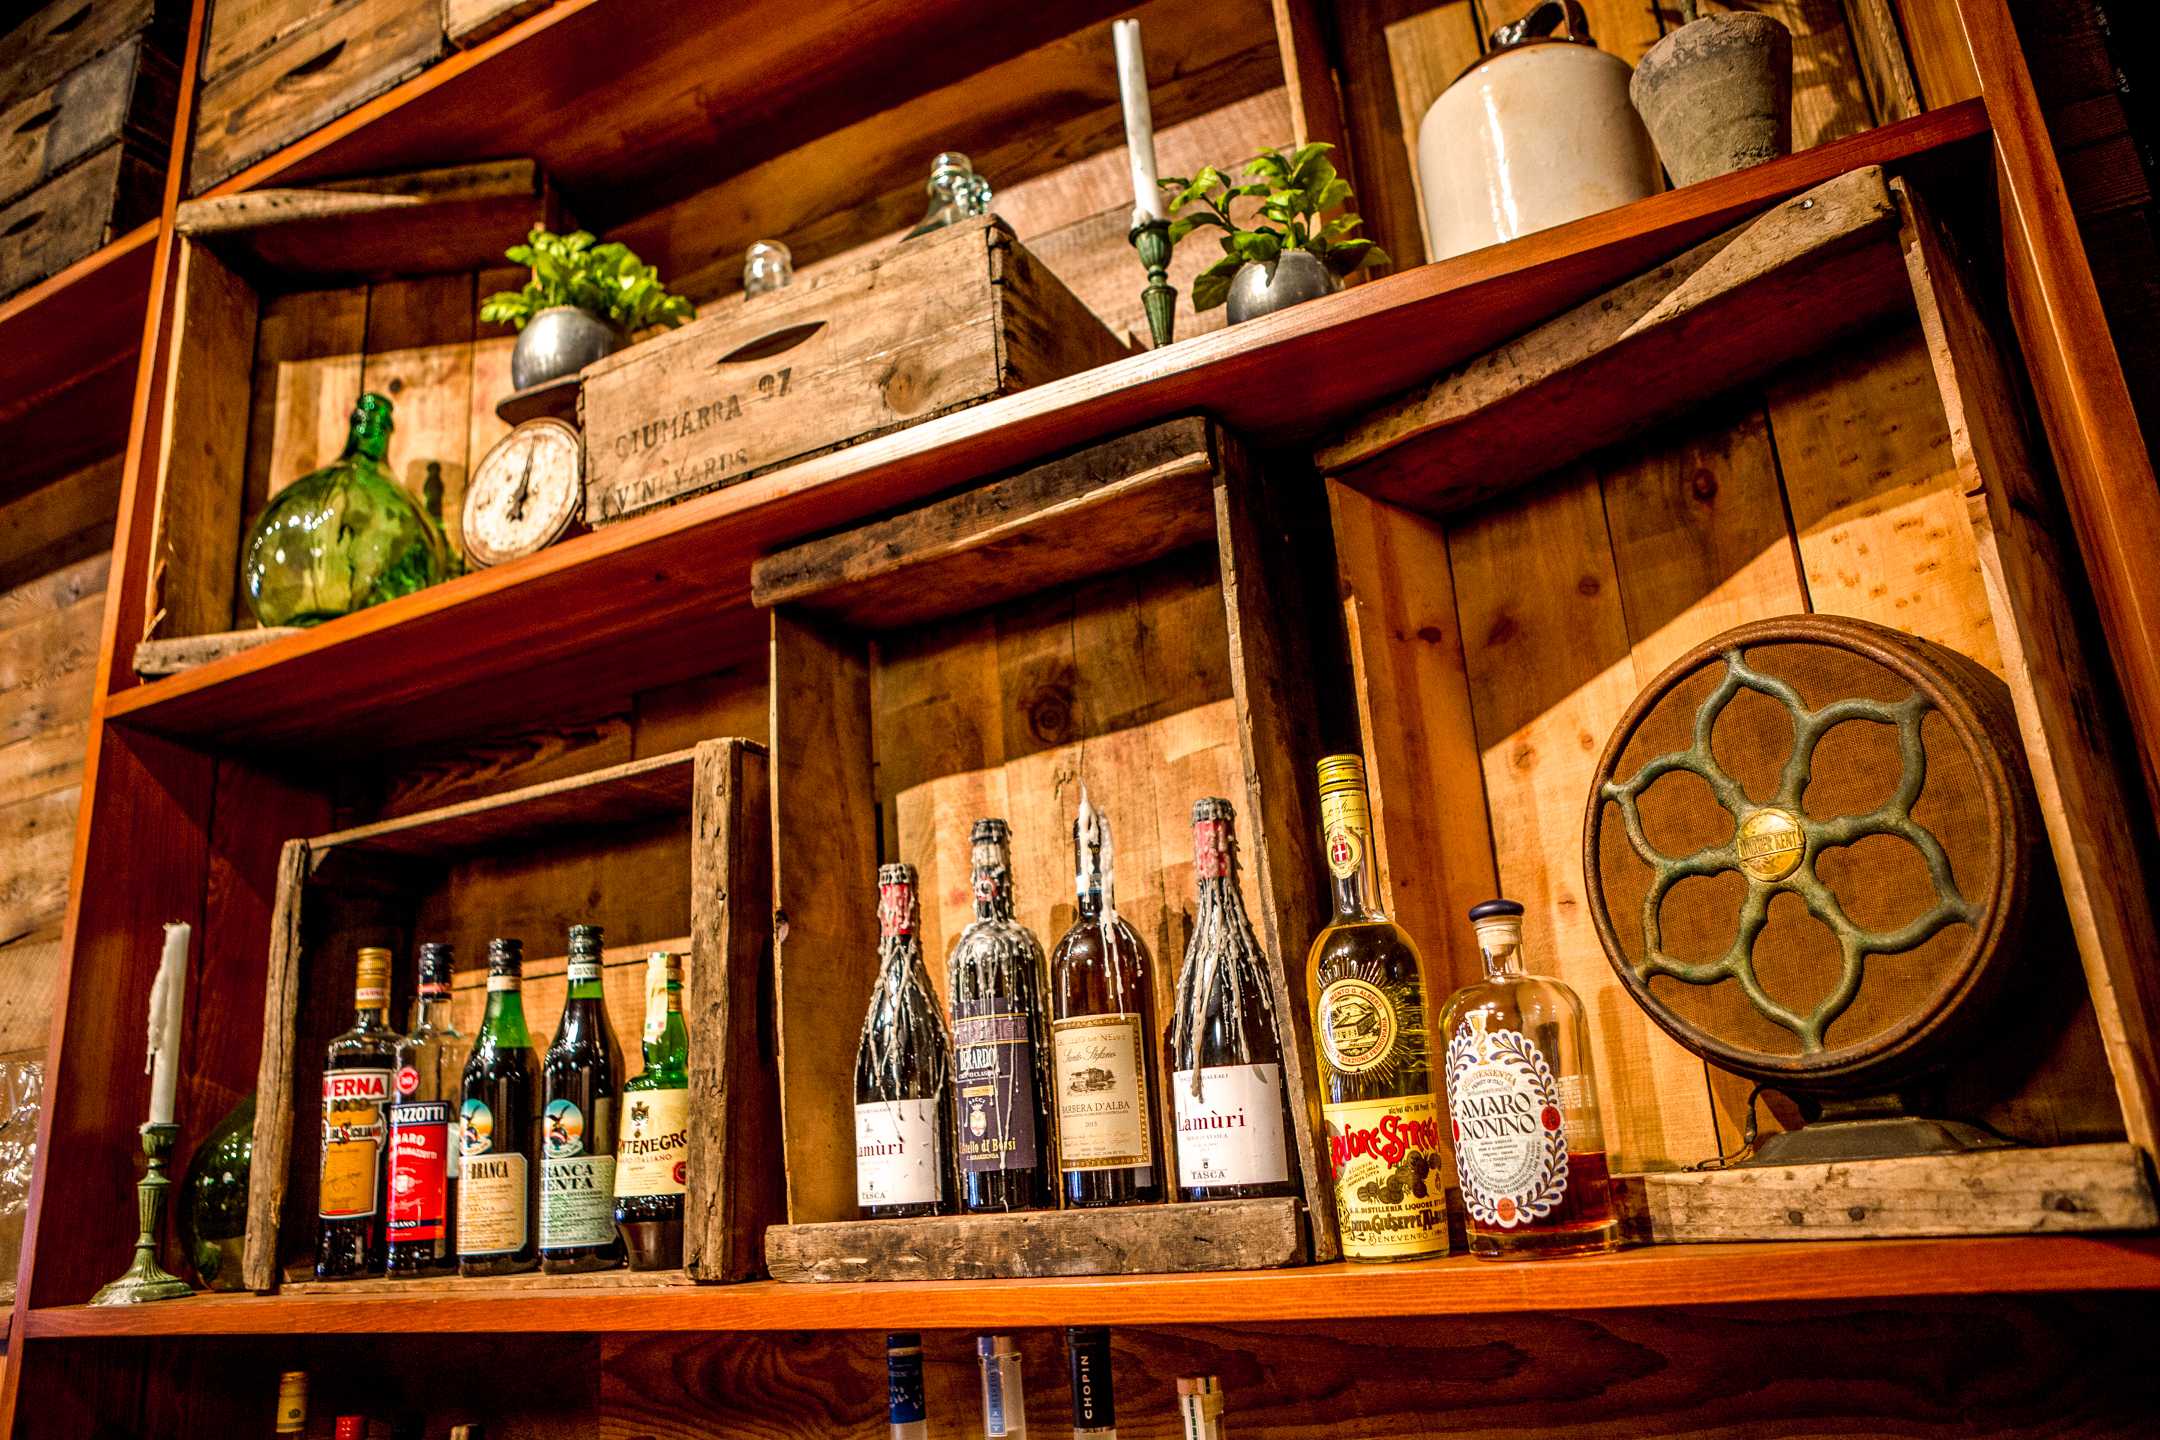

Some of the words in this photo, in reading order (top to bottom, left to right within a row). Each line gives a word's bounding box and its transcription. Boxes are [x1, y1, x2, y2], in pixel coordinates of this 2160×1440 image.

[1095, 1101, 1130, 1113] D'ALBA
[1462, 1092, 1531, 1120] AMARO
[1177, 1107, 1247, 1132] Lamùri
[1462, 1113, 1537, 1141] NONINO
[1191, 1170, 1226, 1180] TASCA
[1369, 1231, 1429, 1246] BENEVENTO
[1081, 1354, 1093, 1420] CHOPIN
